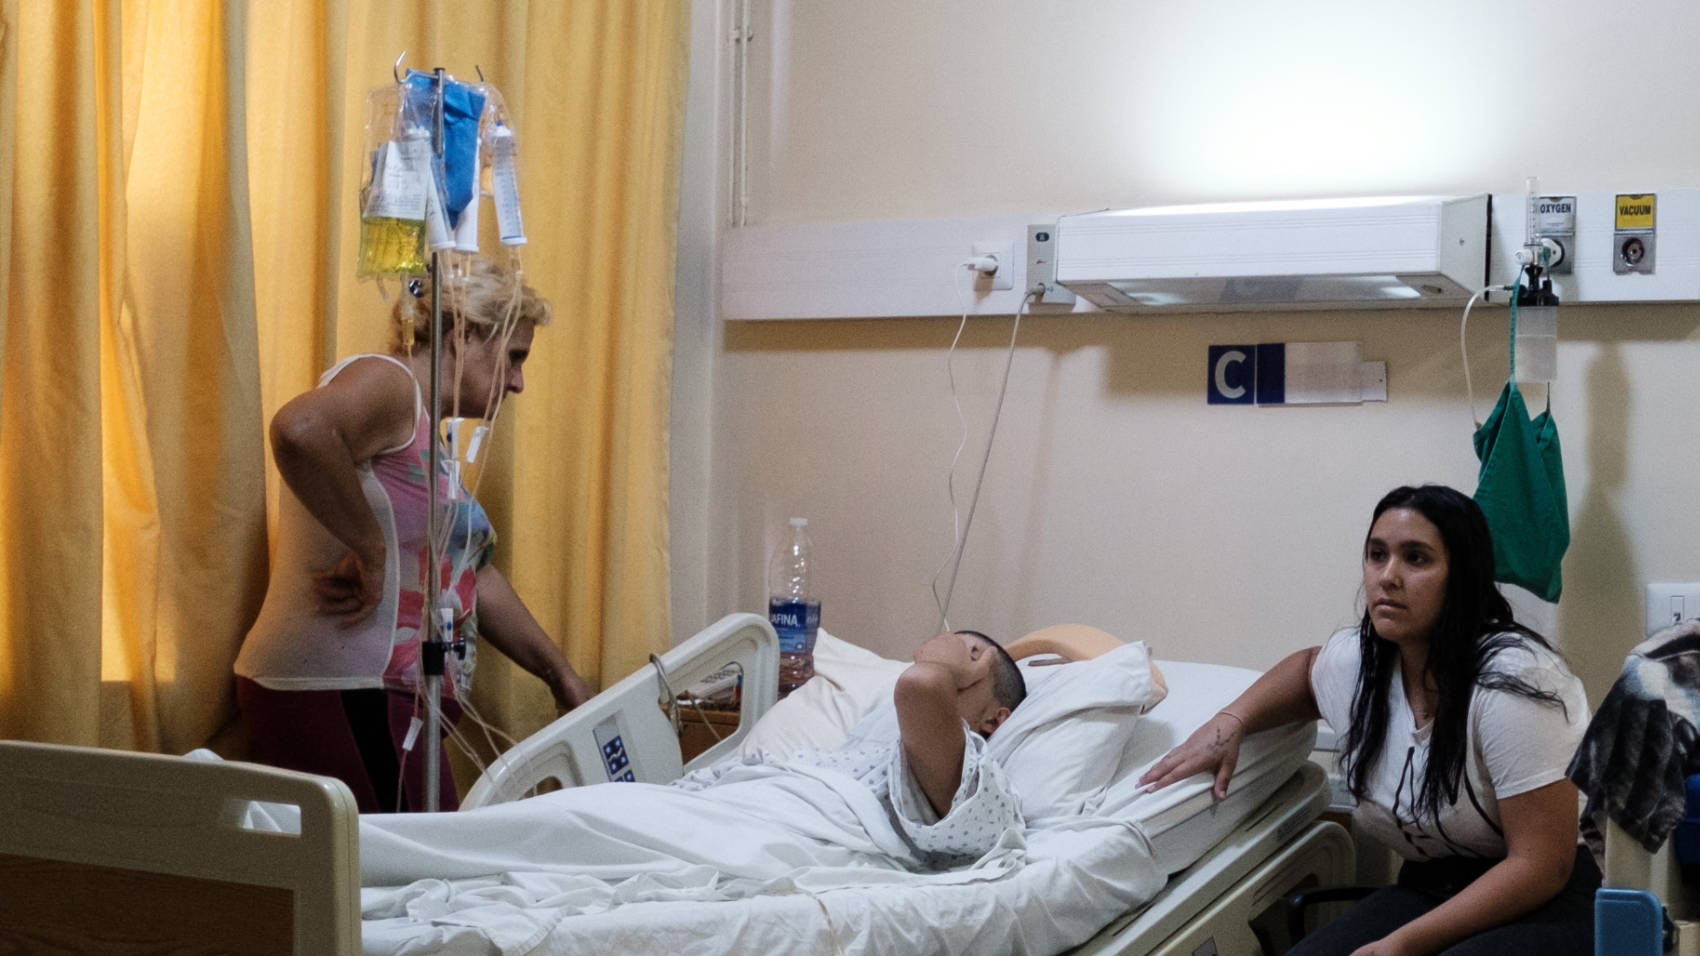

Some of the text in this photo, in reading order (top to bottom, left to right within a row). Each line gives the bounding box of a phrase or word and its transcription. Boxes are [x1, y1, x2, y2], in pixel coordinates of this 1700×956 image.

[1540, 203, 1571, 214] OXYGEN
[1619, 205, 1651, 216] VACUUM
[1215, 350, 1247, 399] C
